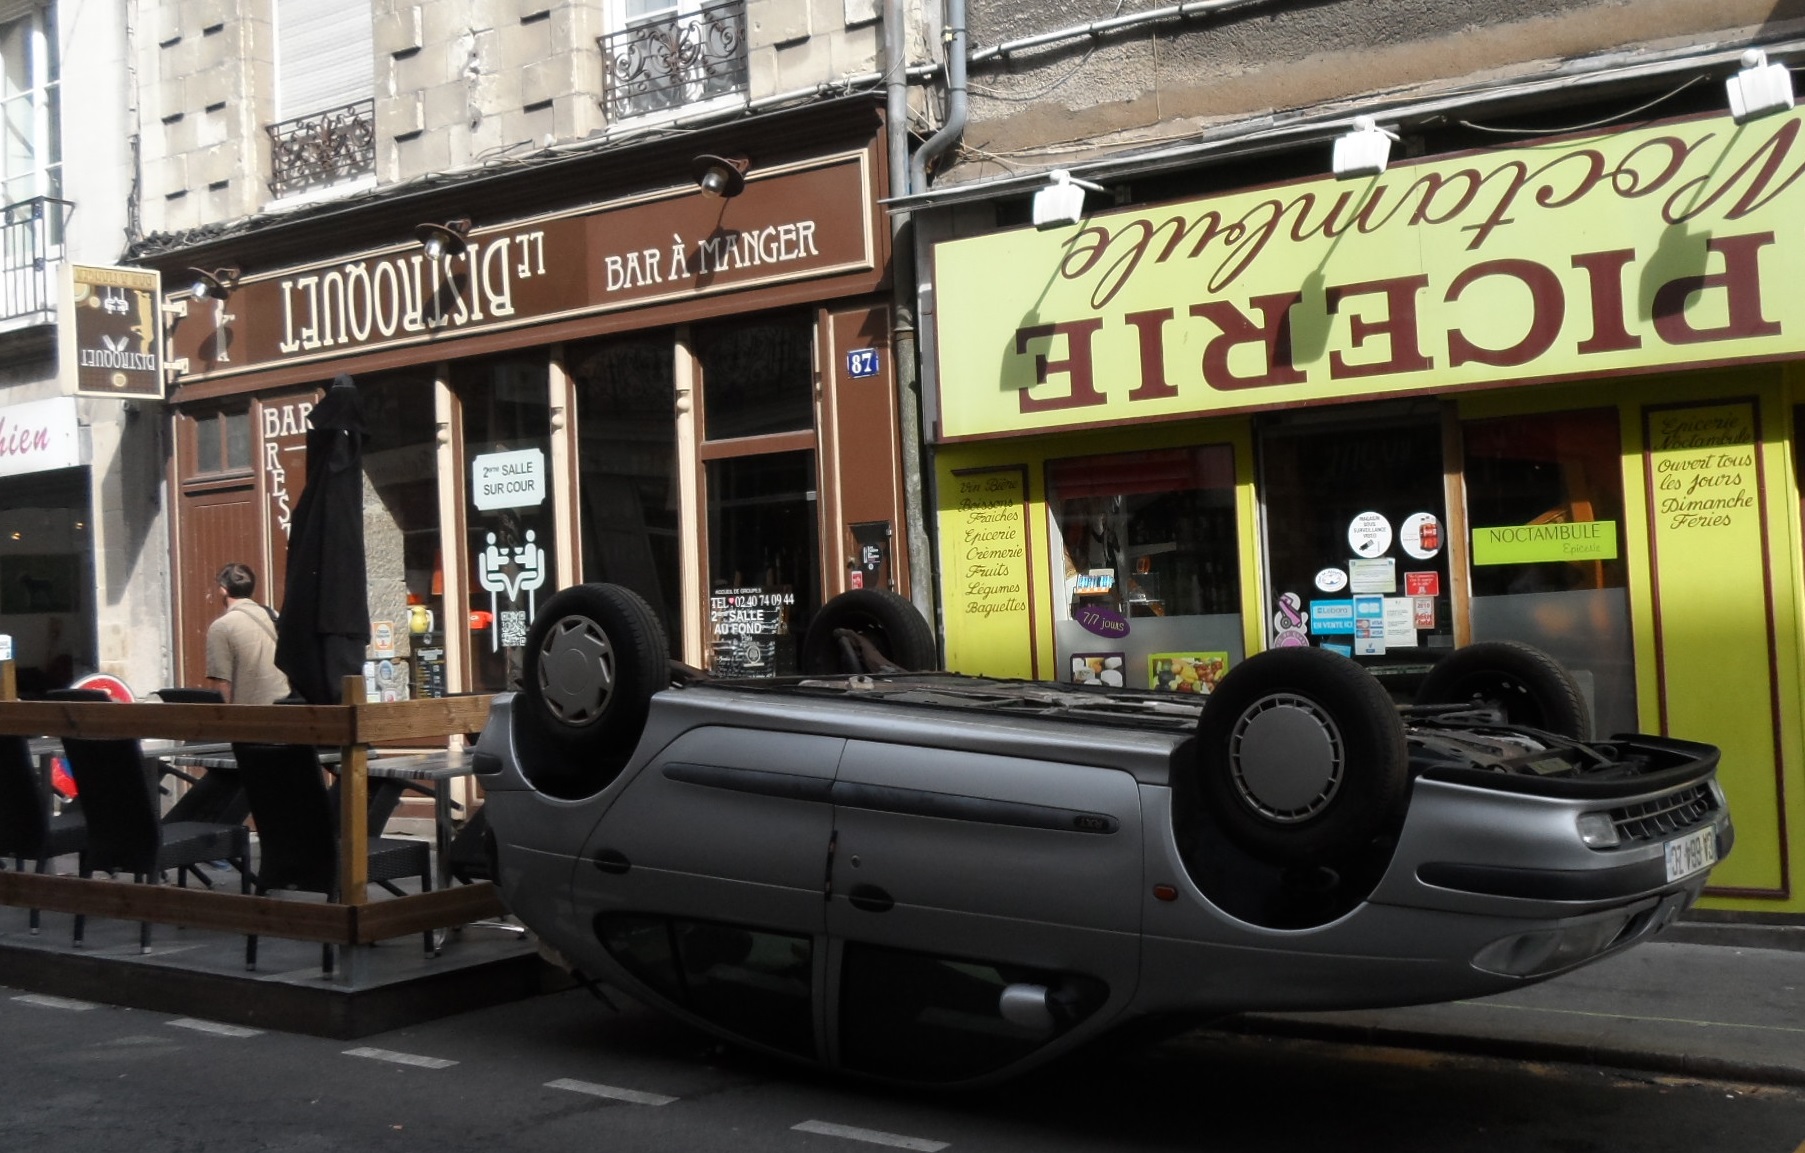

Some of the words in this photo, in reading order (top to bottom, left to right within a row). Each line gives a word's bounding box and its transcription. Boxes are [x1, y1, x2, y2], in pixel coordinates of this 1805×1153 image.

[1061, 117, 1805, 310] Noctambule
[516, 231, 546, 278] LE
[605, 252, 661, 291] BAR
[670, 233, 690, 278] À
[699, 220, 819, 274] MANGER
[280, 237, 515, 353] BISTROQUET
[1015, 230, 1782, 414] PICERIE
[81, 349, 156, 371] BISTROQUET
[851, 353, 873, 374] 87
[263, 403, 314, 438] BAR
[502, 461, 533, 476] SALLE
[1657, 455, 1712, 473] Ouvert
[1717, 453, 1752, 468] tous
[483, 483, 504, 495] SUR
[507, 480, 535, 493] COUR
[1659, 474, 1682, 491] les
[958, 498, 1014, 512] Boissons
[1661, 489, 1753, 514] Dimanche
[965, 526, 1017, 545] Epicerie
[1490, 524, 1601, 544] NOCTAMBULE
[965, 563, 1009, 579] Fruits
[735, 596, 745, 607] 02
[747, 595, 758, 607] 40
[759, 595, 769, 606] 74
[771, 594, 781, 606] 09
[783, 593, 795, 605] 44
[964, 581, 1021, 601] Légumes
[729, 610, 764, 621] SALLE
[965, 597, 1027, 618] Baguettes
[1083, 611, 1100, 625] 7/7
[714, 624, 729, 635] AU
[732, 623, 762, 635] FOND
